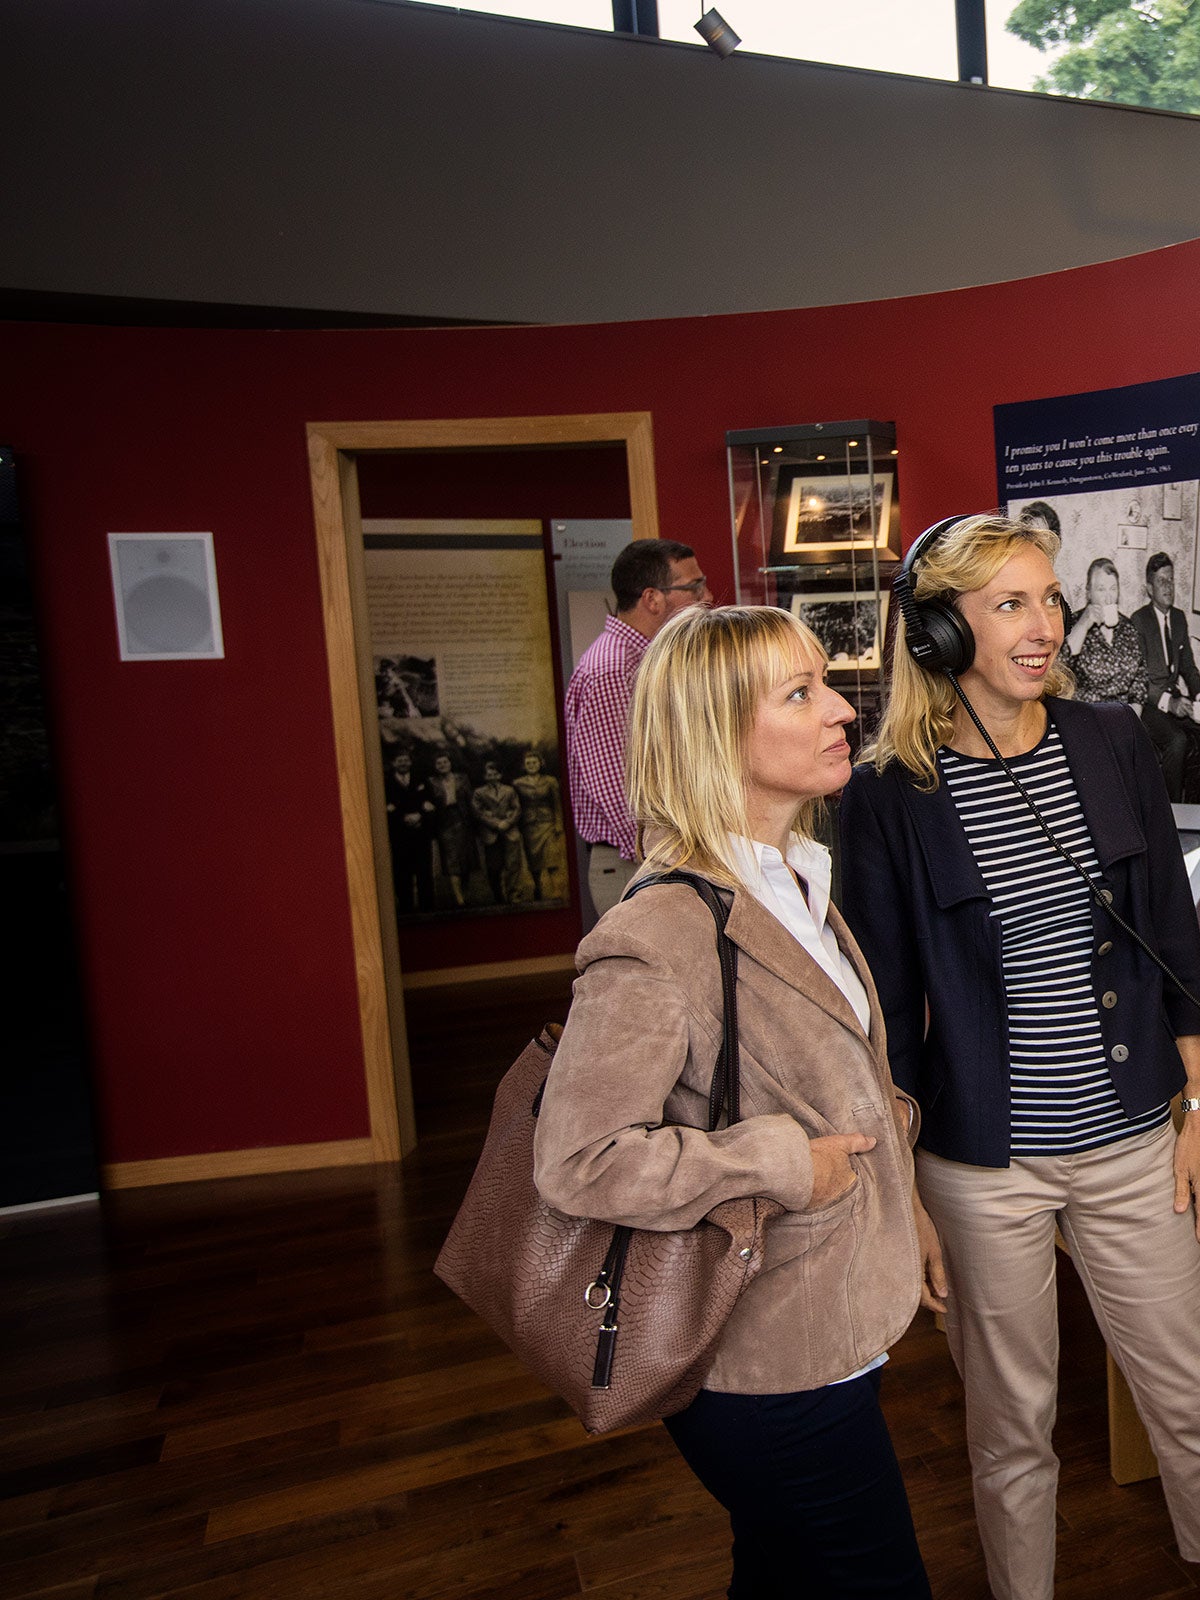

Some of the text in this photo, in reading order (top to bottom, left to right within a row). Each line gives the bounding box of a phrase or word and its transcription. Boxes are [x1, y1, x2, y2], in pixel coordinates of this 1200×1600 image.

[1004, 423, 1199, 460] I promise you I won't come more than once every
[1005, 444, 1170, 476] ten years to cause you this trouble again.
